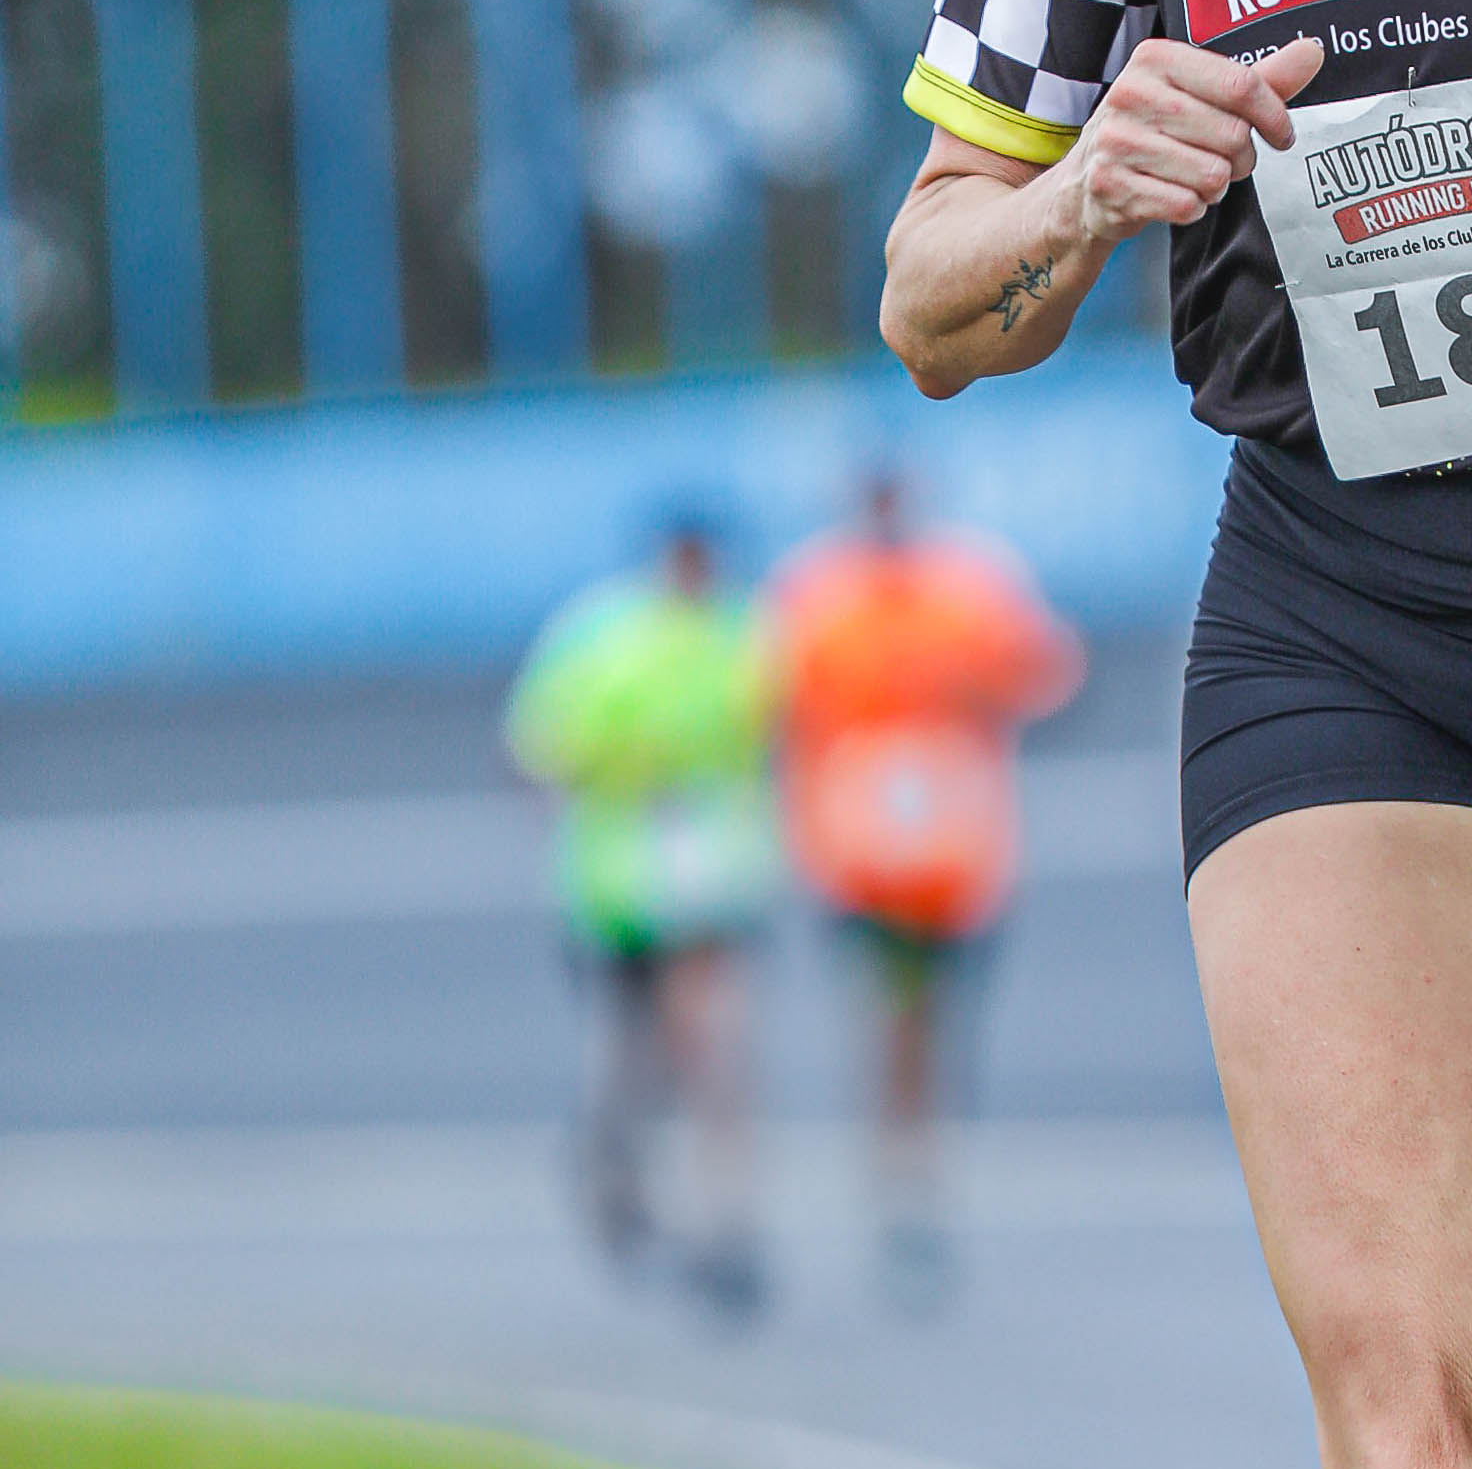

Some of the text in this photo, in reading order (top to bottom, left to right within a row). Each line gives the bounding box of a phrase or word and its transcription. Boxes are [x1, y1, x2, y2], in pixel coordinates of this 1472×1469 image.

[1329, 24, 1372, 54] los
[1378, 11, 1469, 47] Clubes
[1358, 183, 1466, 235] RUNNING
[1325, 253, 1343, 269] La
[1345, 244, 1400, 267] Carrera
[1402, 239, 1421, 254] de
[1423, 233, 1446, 251] los
